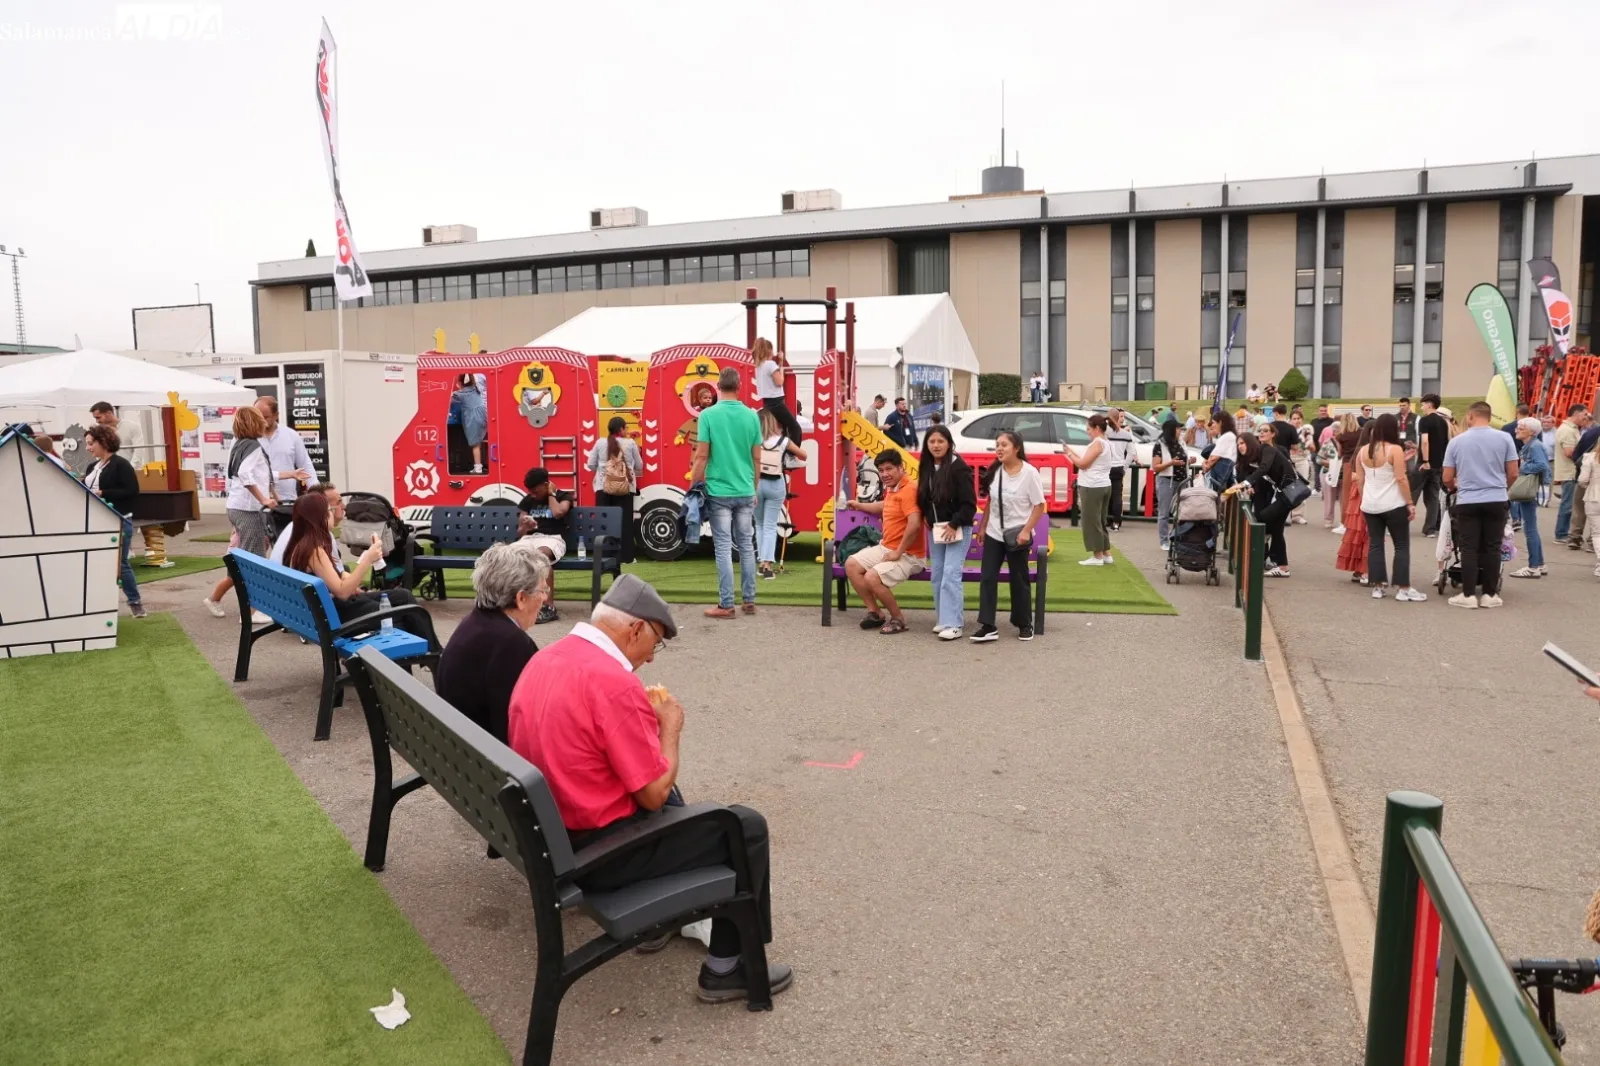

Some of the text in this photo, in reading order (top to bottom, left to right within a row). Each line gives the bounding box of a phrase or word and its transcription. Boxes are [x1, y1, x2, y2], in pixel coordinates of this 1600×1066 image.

[286, 372, 324, 380] DISTRIBUIDOR
[292, 408, 321, 418] GEHL
[417, 429, 437, 441] 112
